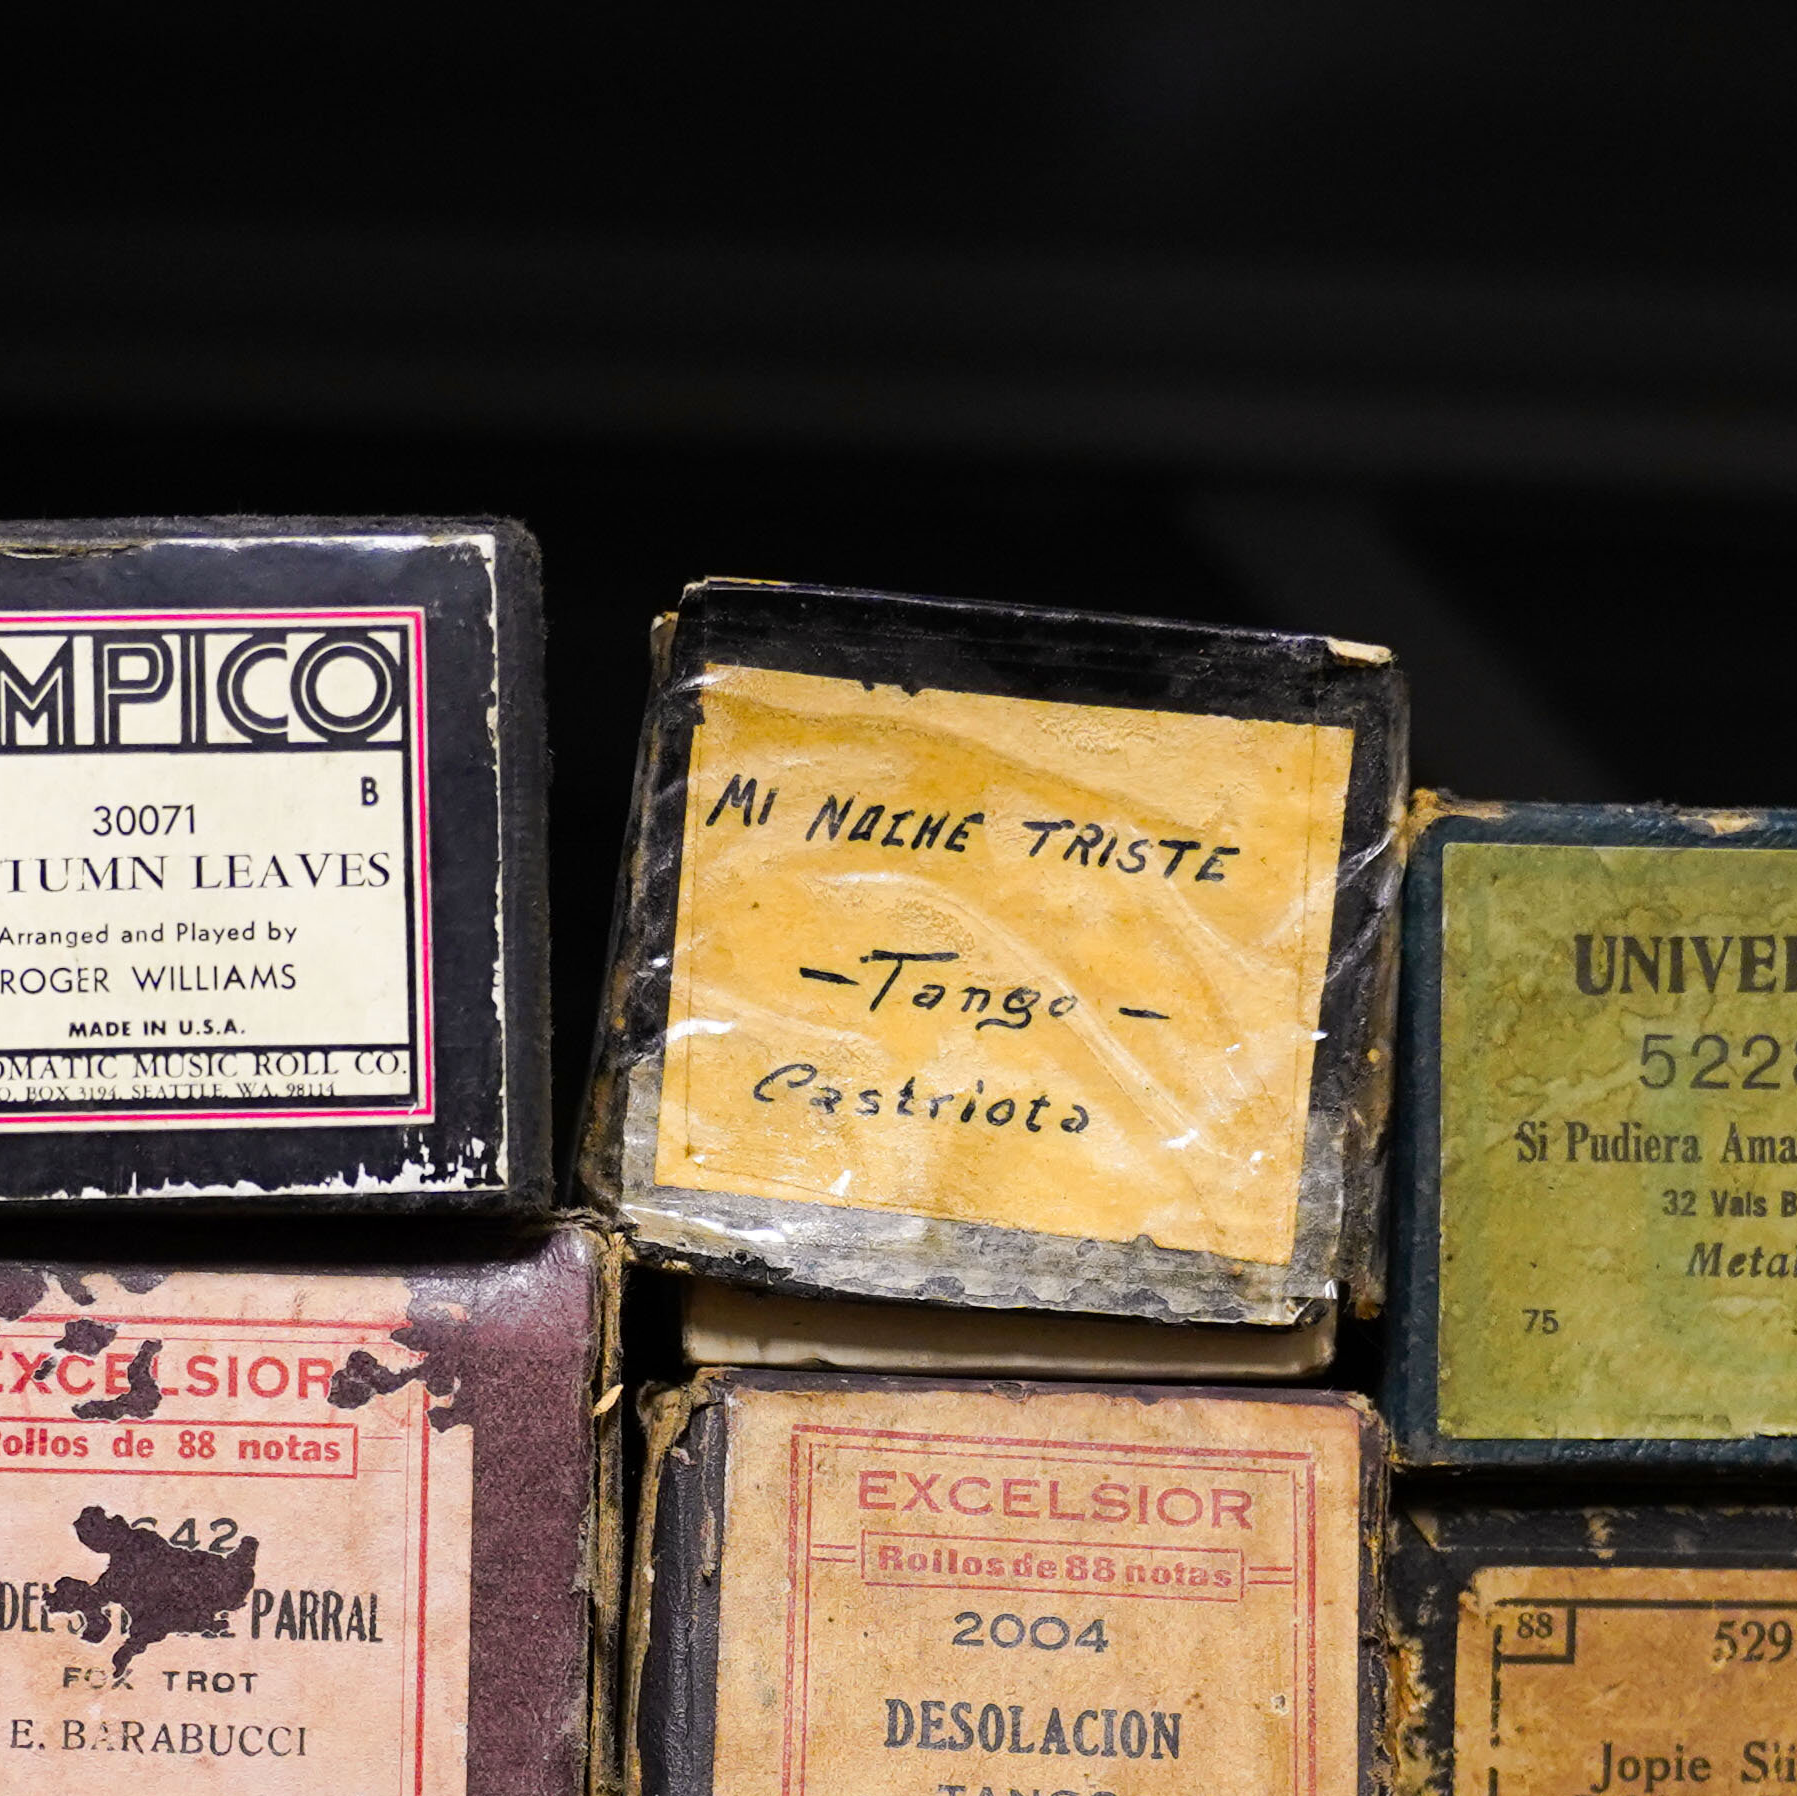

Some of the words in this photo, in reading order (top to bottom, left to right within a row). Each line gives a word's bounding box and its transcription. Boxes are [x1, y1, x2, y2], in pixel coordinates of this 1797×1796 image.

[92, 805, 196, 835] 30071
[706, 774, 778, 826] MI
[1023, 819, 1240, 883] TRISTE
[191, 851, 391, 890] LEAVES
[121, 924, 164, 942] and
[176, 923, 254, 944] Played
[267, 922, 297, 943] by
[0, 967, 109, 994] ROGER
[132, 964, 296, 992] WILLIAMS
[133, 1054, 236, 1079] MUSIC
[255, 1053, 339, 1075] ROLL
[355, 1051, 407, 1074] CO.
[1516, 1121, 1547, 1164] Si
[1566, 1124, 1701, 1166] Pudiera
[112, 1428, 154, 1459] de
[177, 1430, 216, 1461] 88
[238, 1434, 341, 1463] notas
[858, 1470, 1253, 1530] EXCELSIOR
[952, 1612, 1109, 1653] 2004
[1517, 1612, 1552, 1639] 88
[11, 1721, 45, 1751] E.
[63, 1722, 307, 1756] BARABUCCI
[884, 1698, 1182, 1760] DESOLACION
